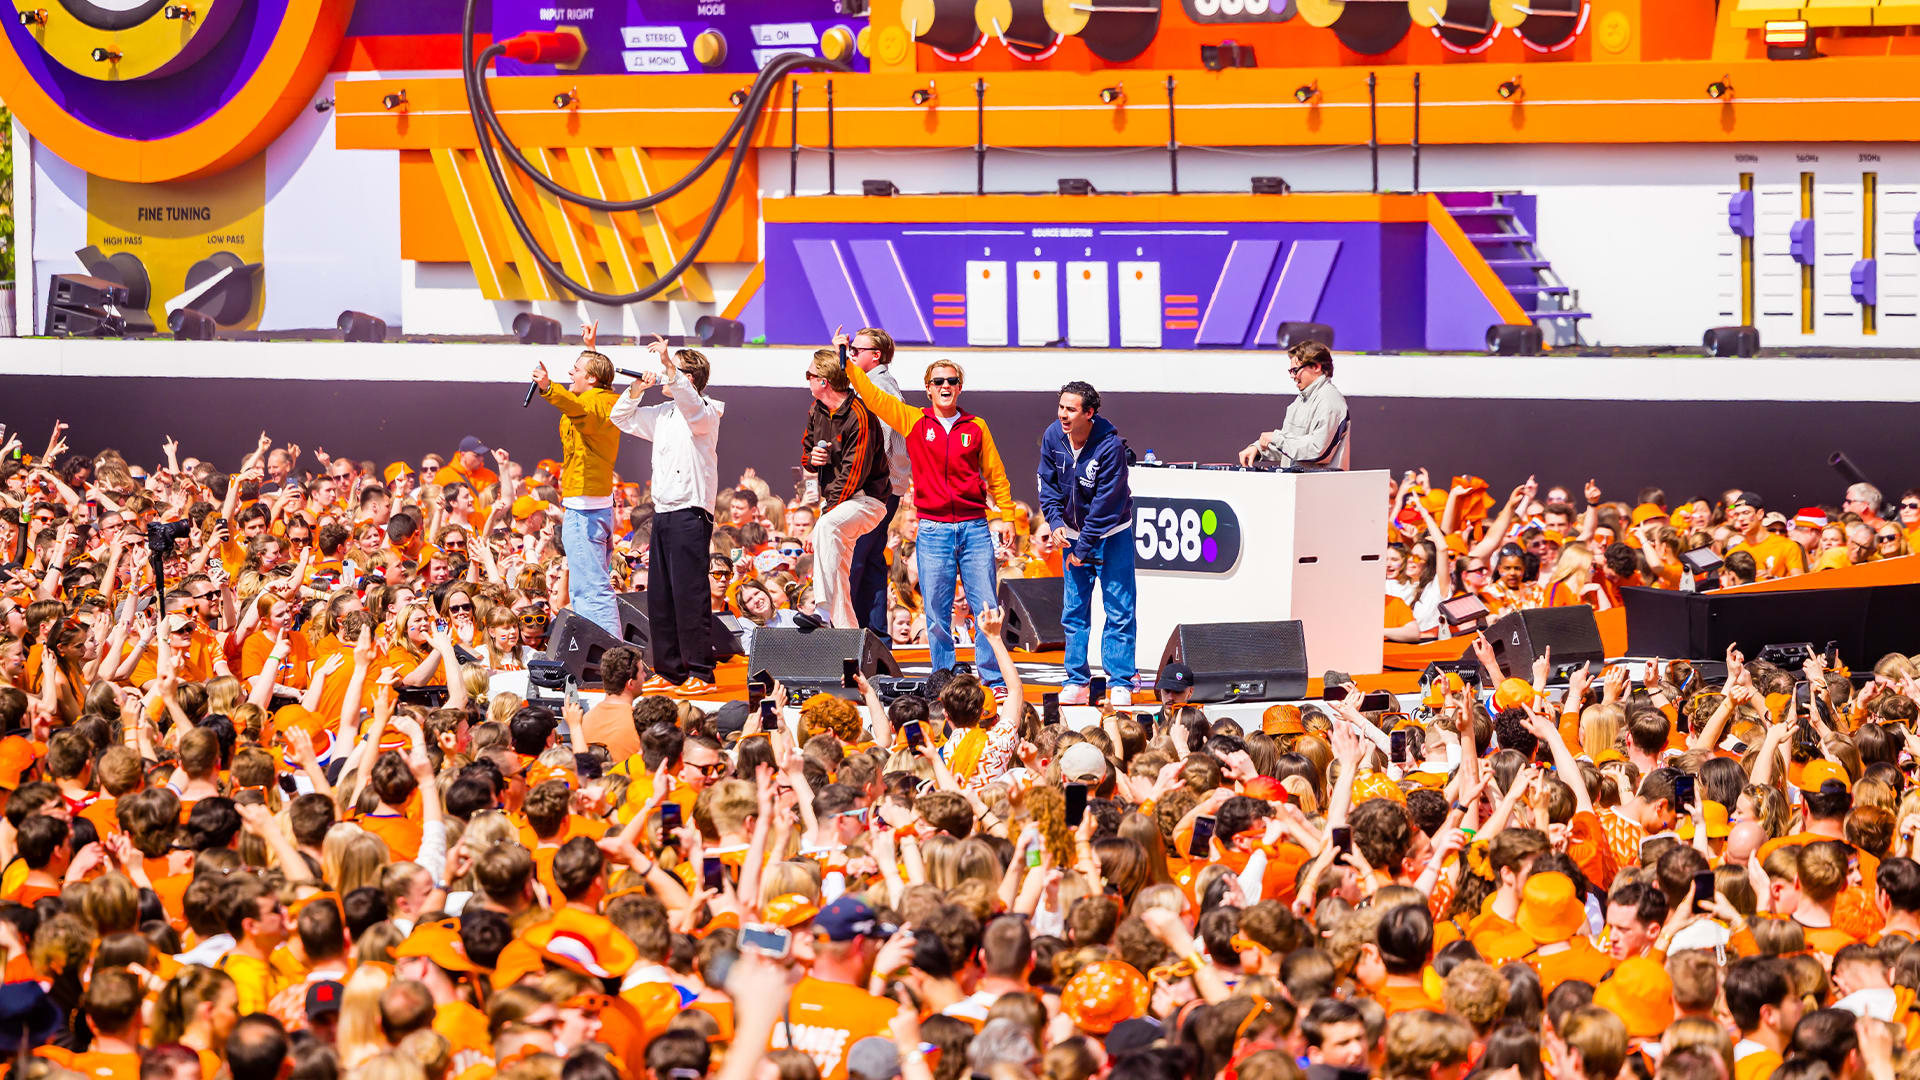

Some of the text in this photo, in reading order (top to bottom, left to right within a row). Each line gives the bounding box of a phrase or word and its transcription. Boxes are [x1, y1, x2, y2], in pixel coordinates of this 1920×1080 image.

[540, 8, 594, 20] INPUT RIGHT
[698, 4, 725, 16] MODE
[645, 33, 676, 43] STEREO
[776, 31, 789, 40] ON
[648, 57, 676, 65] MONO
[138, 207, 211, 221] FINE TUNING
[103, 236, 143, 246] HIGH PASS
[207, 235, 245, 245] LOW PASS
[1135, 507, 1202, 562] 538
